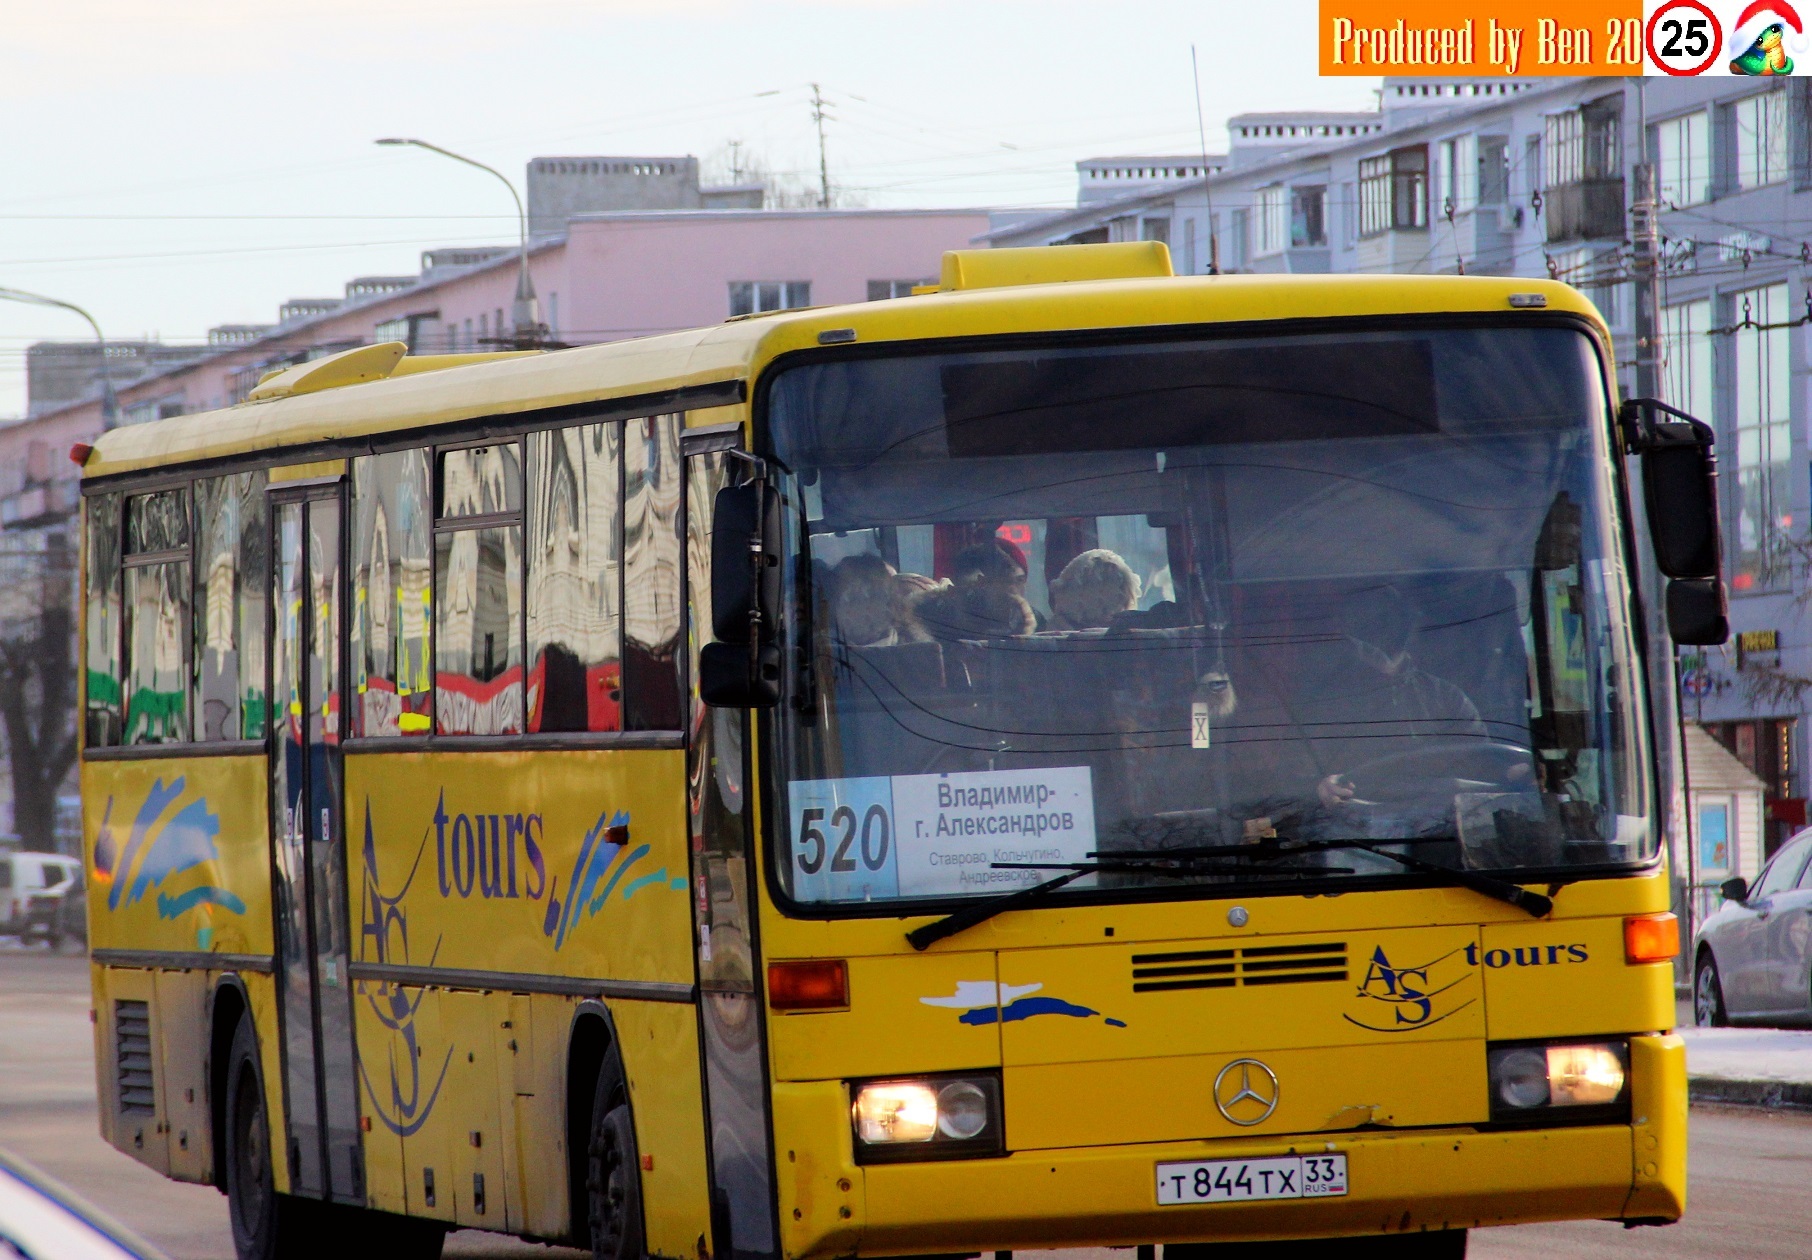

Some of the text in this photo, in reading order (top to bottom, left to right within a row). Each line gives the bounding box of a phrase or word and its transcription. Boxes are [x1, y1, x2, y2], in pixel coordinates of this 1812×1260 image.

[938, 783, 1056, 811] Владимир-
[915, 812, 1075, 838] г. Александров
[433, 785, 547, 900] tours
[798, 804, 889, 875] 520
[1463, 941, 1589, 969] tours
[1305, 1158, 1335, 1183] 33
[1305, 1184, 1327, 1193] RUS
